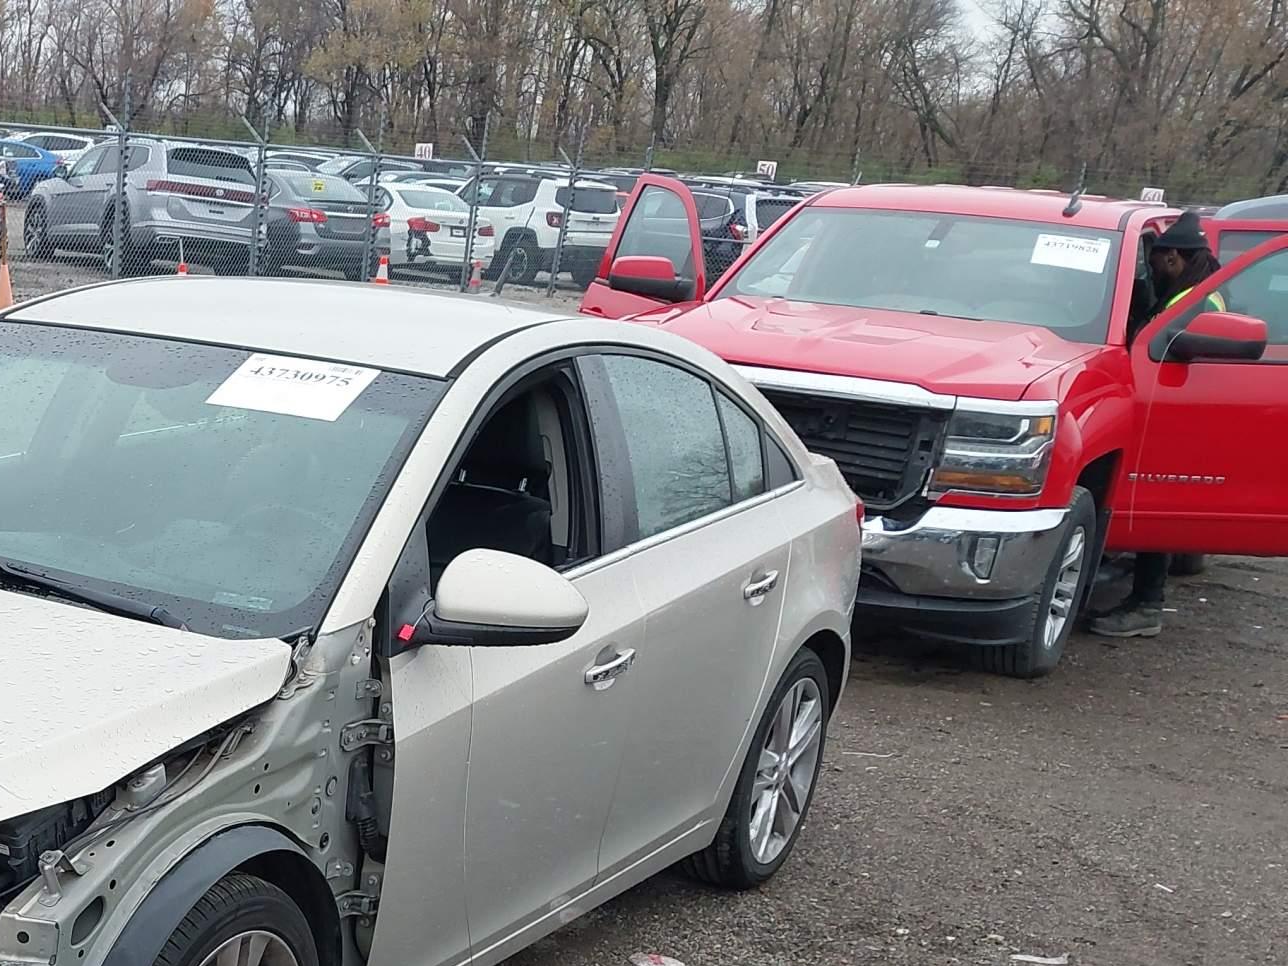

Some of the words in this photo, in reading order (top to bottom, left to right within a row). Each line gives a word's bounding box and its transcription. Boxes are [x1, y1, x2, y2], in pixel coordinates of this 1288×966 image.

[416, 145, 431, 160] 40
[250, 366, 352, 386] 43730975
[1128, 473, 1225, 484] SILVERADO
